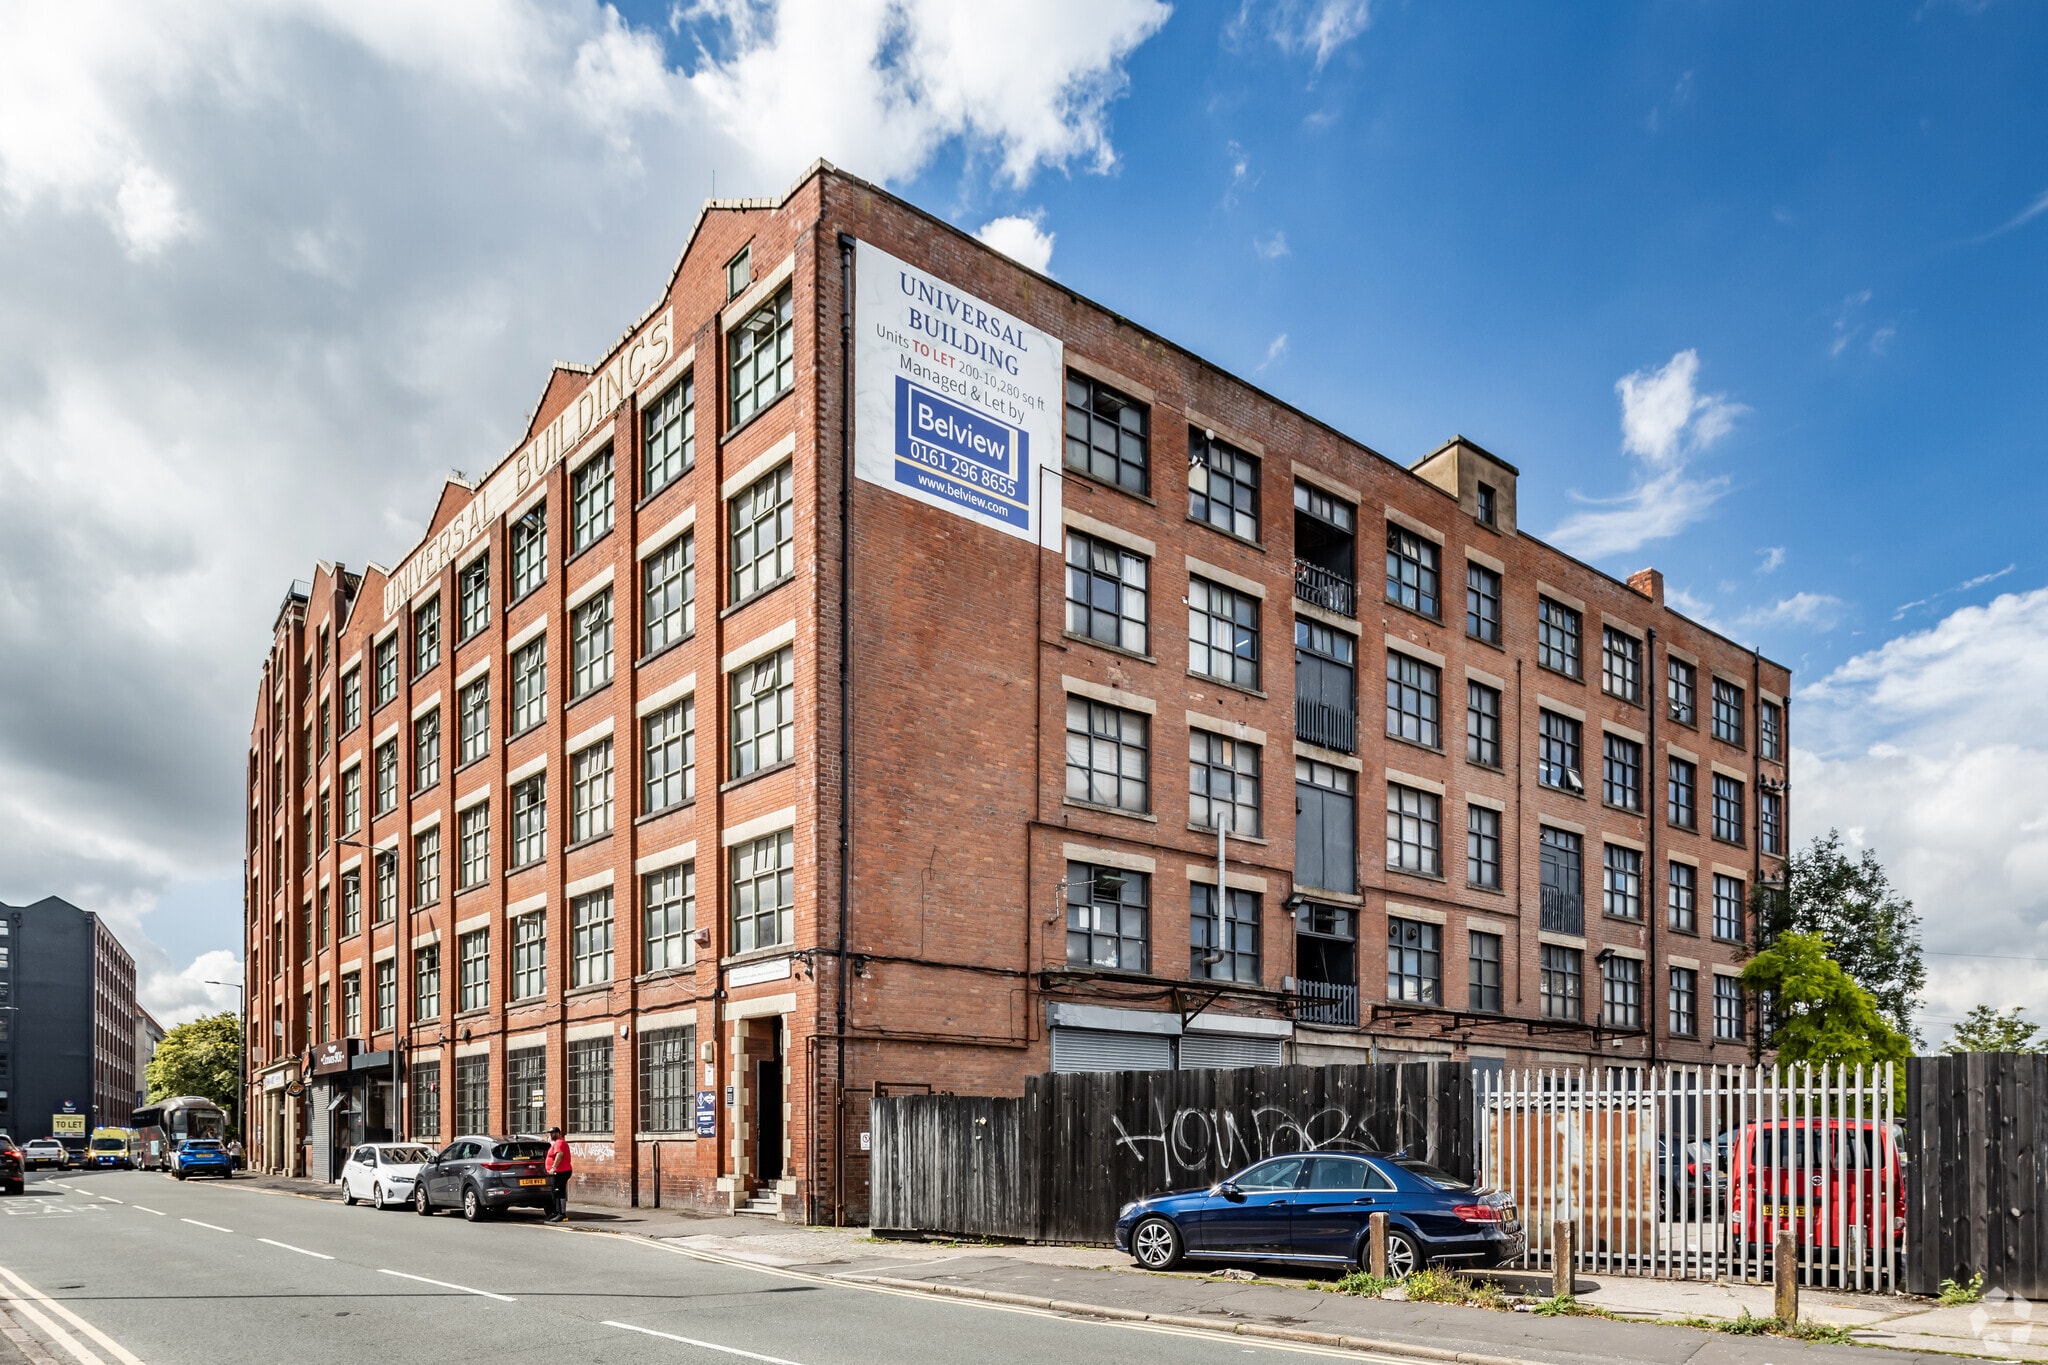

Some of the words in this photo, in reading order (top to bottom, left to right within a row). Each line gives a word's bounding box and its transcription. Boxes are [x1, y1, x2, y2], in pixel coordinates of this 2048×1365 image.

[900, 271, 1028, 352] UNIVERSAL
[908, 306, 1018, 376] BUILDING
[876, 323, 910, 349] Units
[912, 339, 930, 359] TO
[933, 348, 956, 369] LET
[958, 360, 1020, 400] 200-10,280
[1022, 391, 1035, 409] sq
[1036, 398, 1046, 412] ft
[900, 353, 967, 398] Managed
[970, 385, 981, 403] &
[984, 391, 1006, 415] Let
[1008, 401, 1025, 425] by
[385, 490, 496, 616] UNIVERSAL
[516, 314, 669, 497] BUILDINGS
[918, 402, 1006, 461] Belview
[910, 441, 947, 471] 0161
[951, 457, 978, 482] 296
[981, 470, 1016, 497] 8655
[918, 473, 1009, 518] www.belview.com
